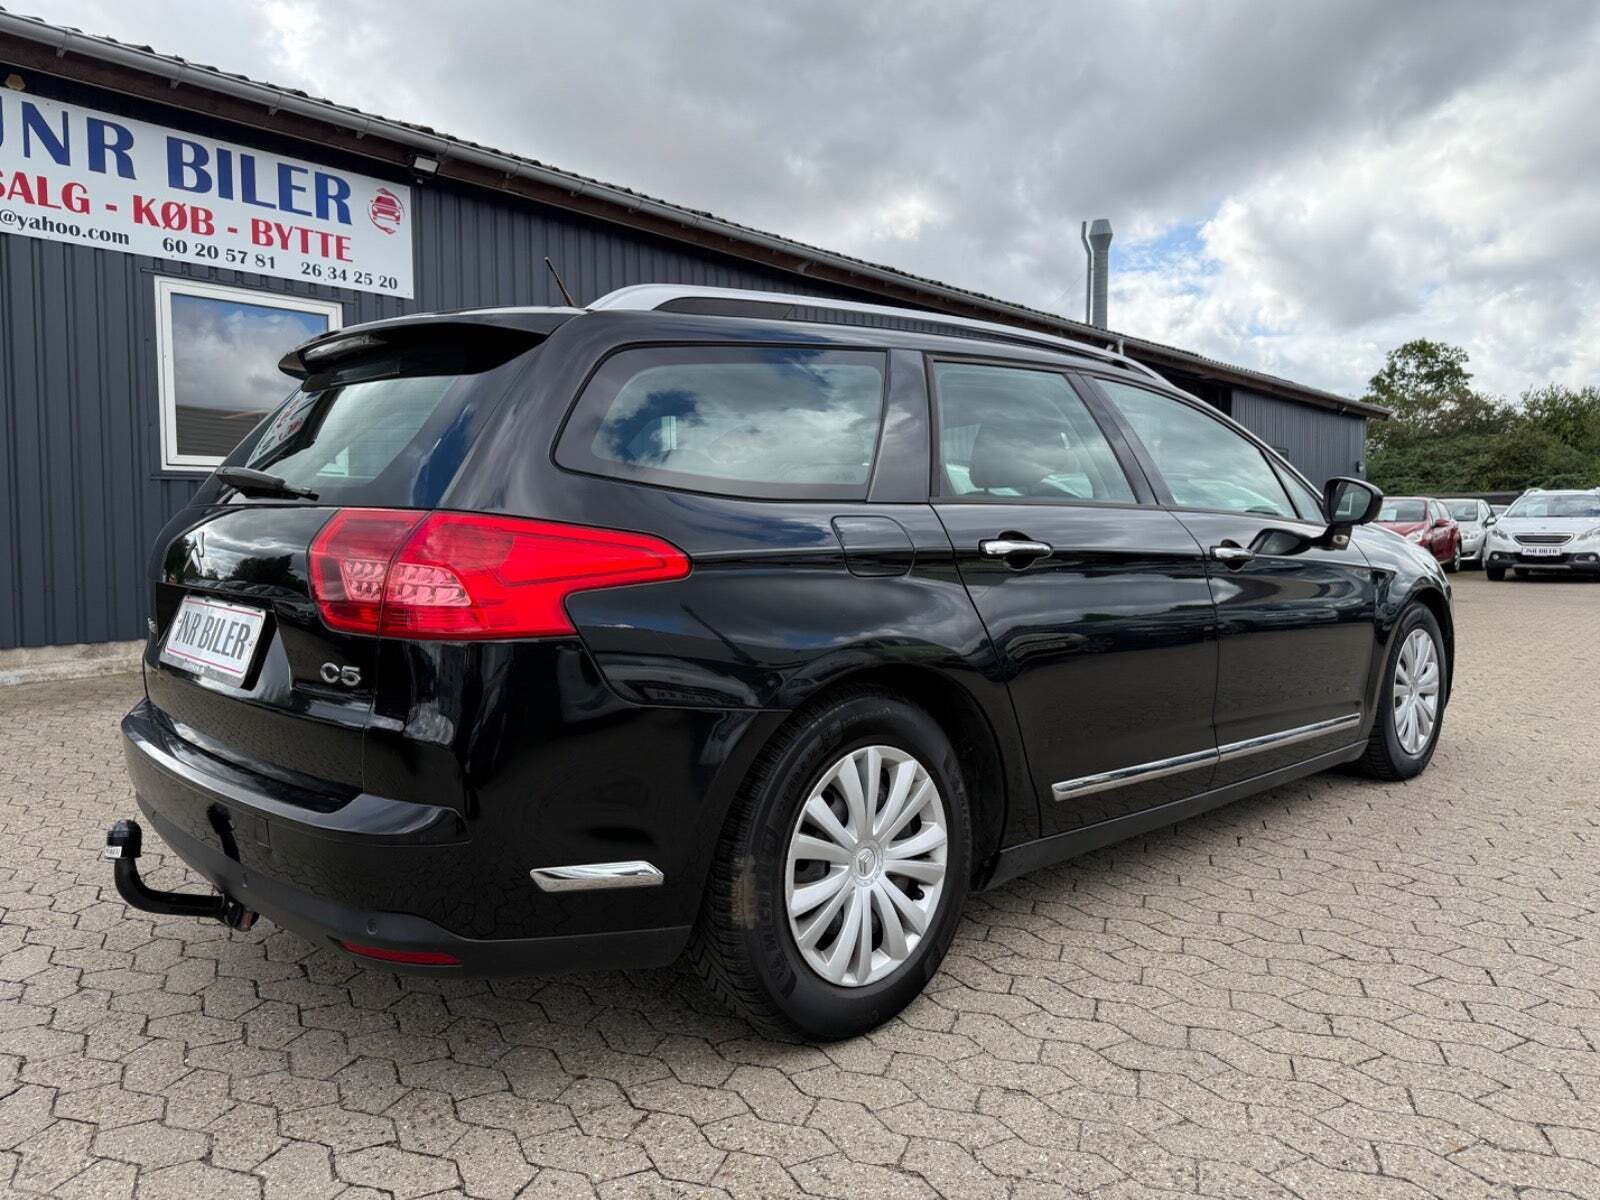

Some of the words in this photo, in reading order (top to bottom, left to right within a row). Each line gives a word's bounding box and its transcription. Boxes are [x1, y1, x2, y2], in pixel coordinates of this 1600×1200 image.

[0, 96, 136, 180] NR
[166, 136, 353, 225] BILER
[0, 209, 130, 245] @yahoo.com
[162, 237, 188, 254] 60
[194, 242, 219, 260] 20
[225, 247, 248, 265] 57
[255, 253, 276, 269] 81
[301, 261, 323, 278] 26
[327, 265, 348, 283] 34
[353, 270, 373, 287] 25
[379, 274, 398, 290] 20
[133, 195, 215, 236] KØB
[251, 218, 353, 262] BYTTE
[197, 614, 251, 660] BILER
[320, 662, 361, 686] C5
